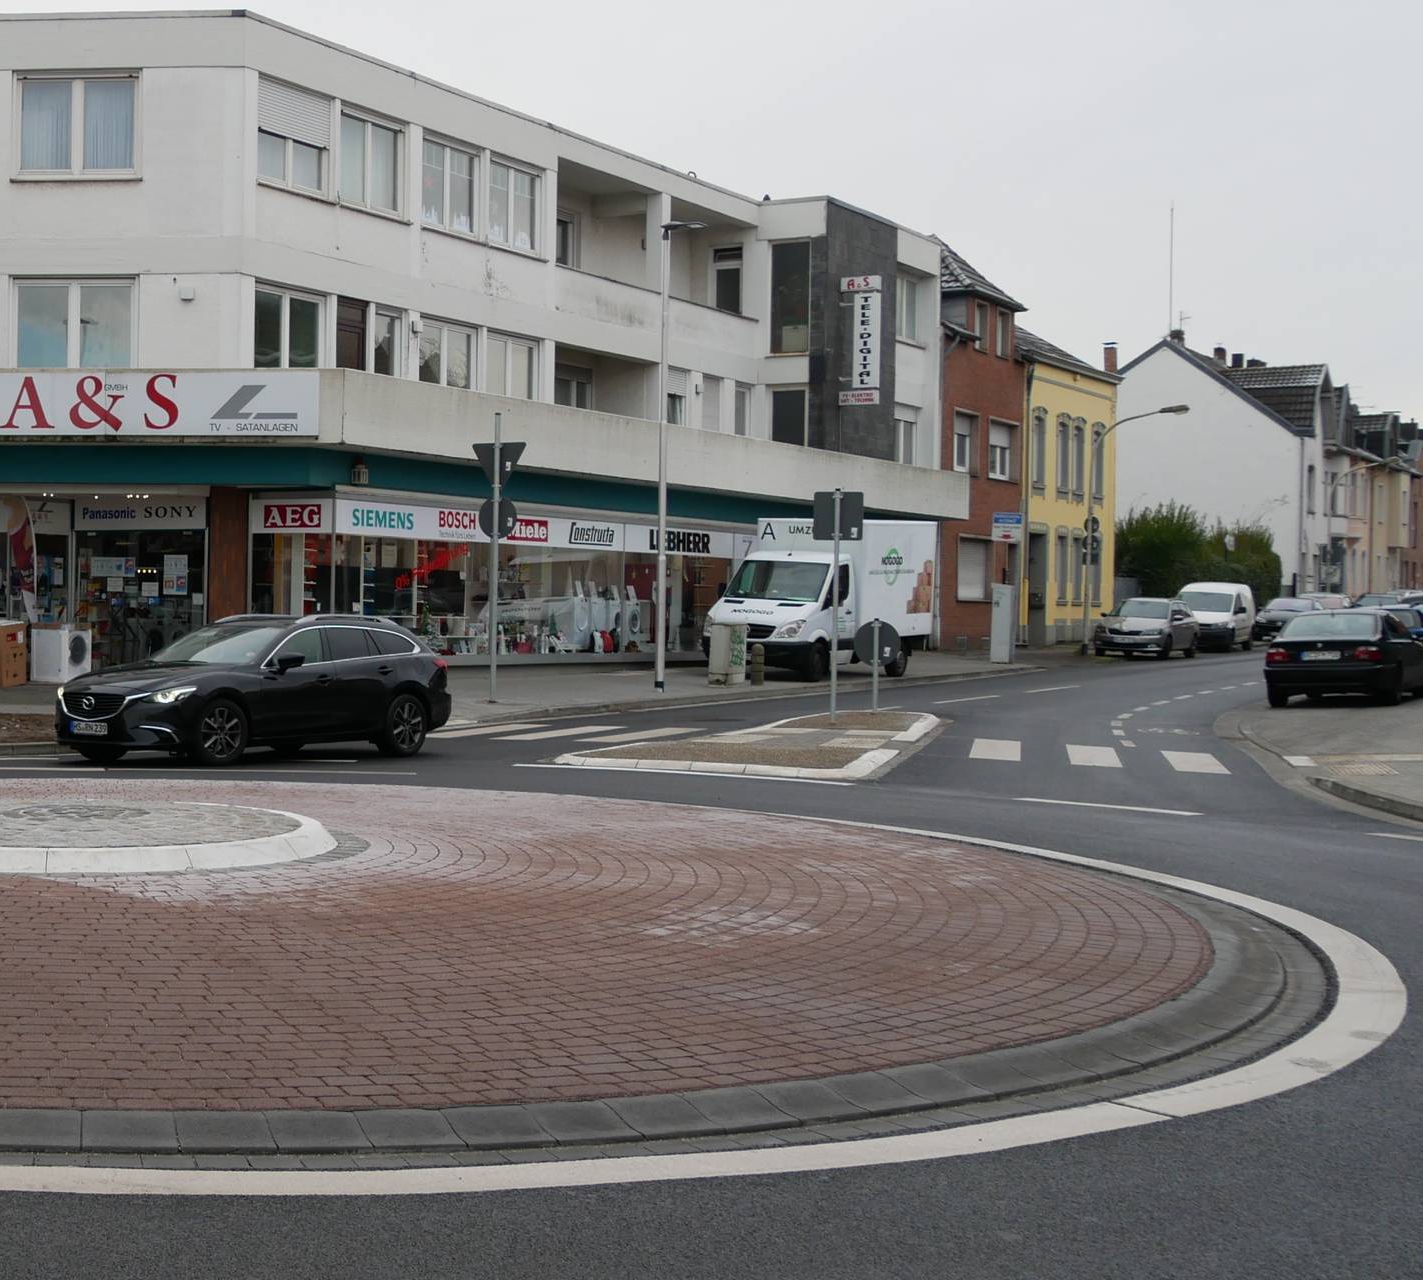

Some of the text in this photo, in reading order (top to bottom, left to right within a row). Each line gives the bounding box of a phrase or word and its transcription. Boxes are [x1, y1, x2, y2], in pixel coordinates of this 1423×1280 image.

[0, 373, 179, 432] A & S
[210, 423, 221, 432] TV
[236, 423, 299, 432] SATANLAGEN
[82, 505, 197, 520] Panasonic SONY
[265, 506, 321, 527] AEG
[352, 508, 415, 530] SIEMENS
[438, 510, 476, 530] BOSCH
[508, 521, 548, 541] Miele
[568, 521, 615, 546] Constructa
[761, 523, 776, 541] A
[789, 525, 814, 535] UMZ
[649, 528, 711, 553] LEBHERR
